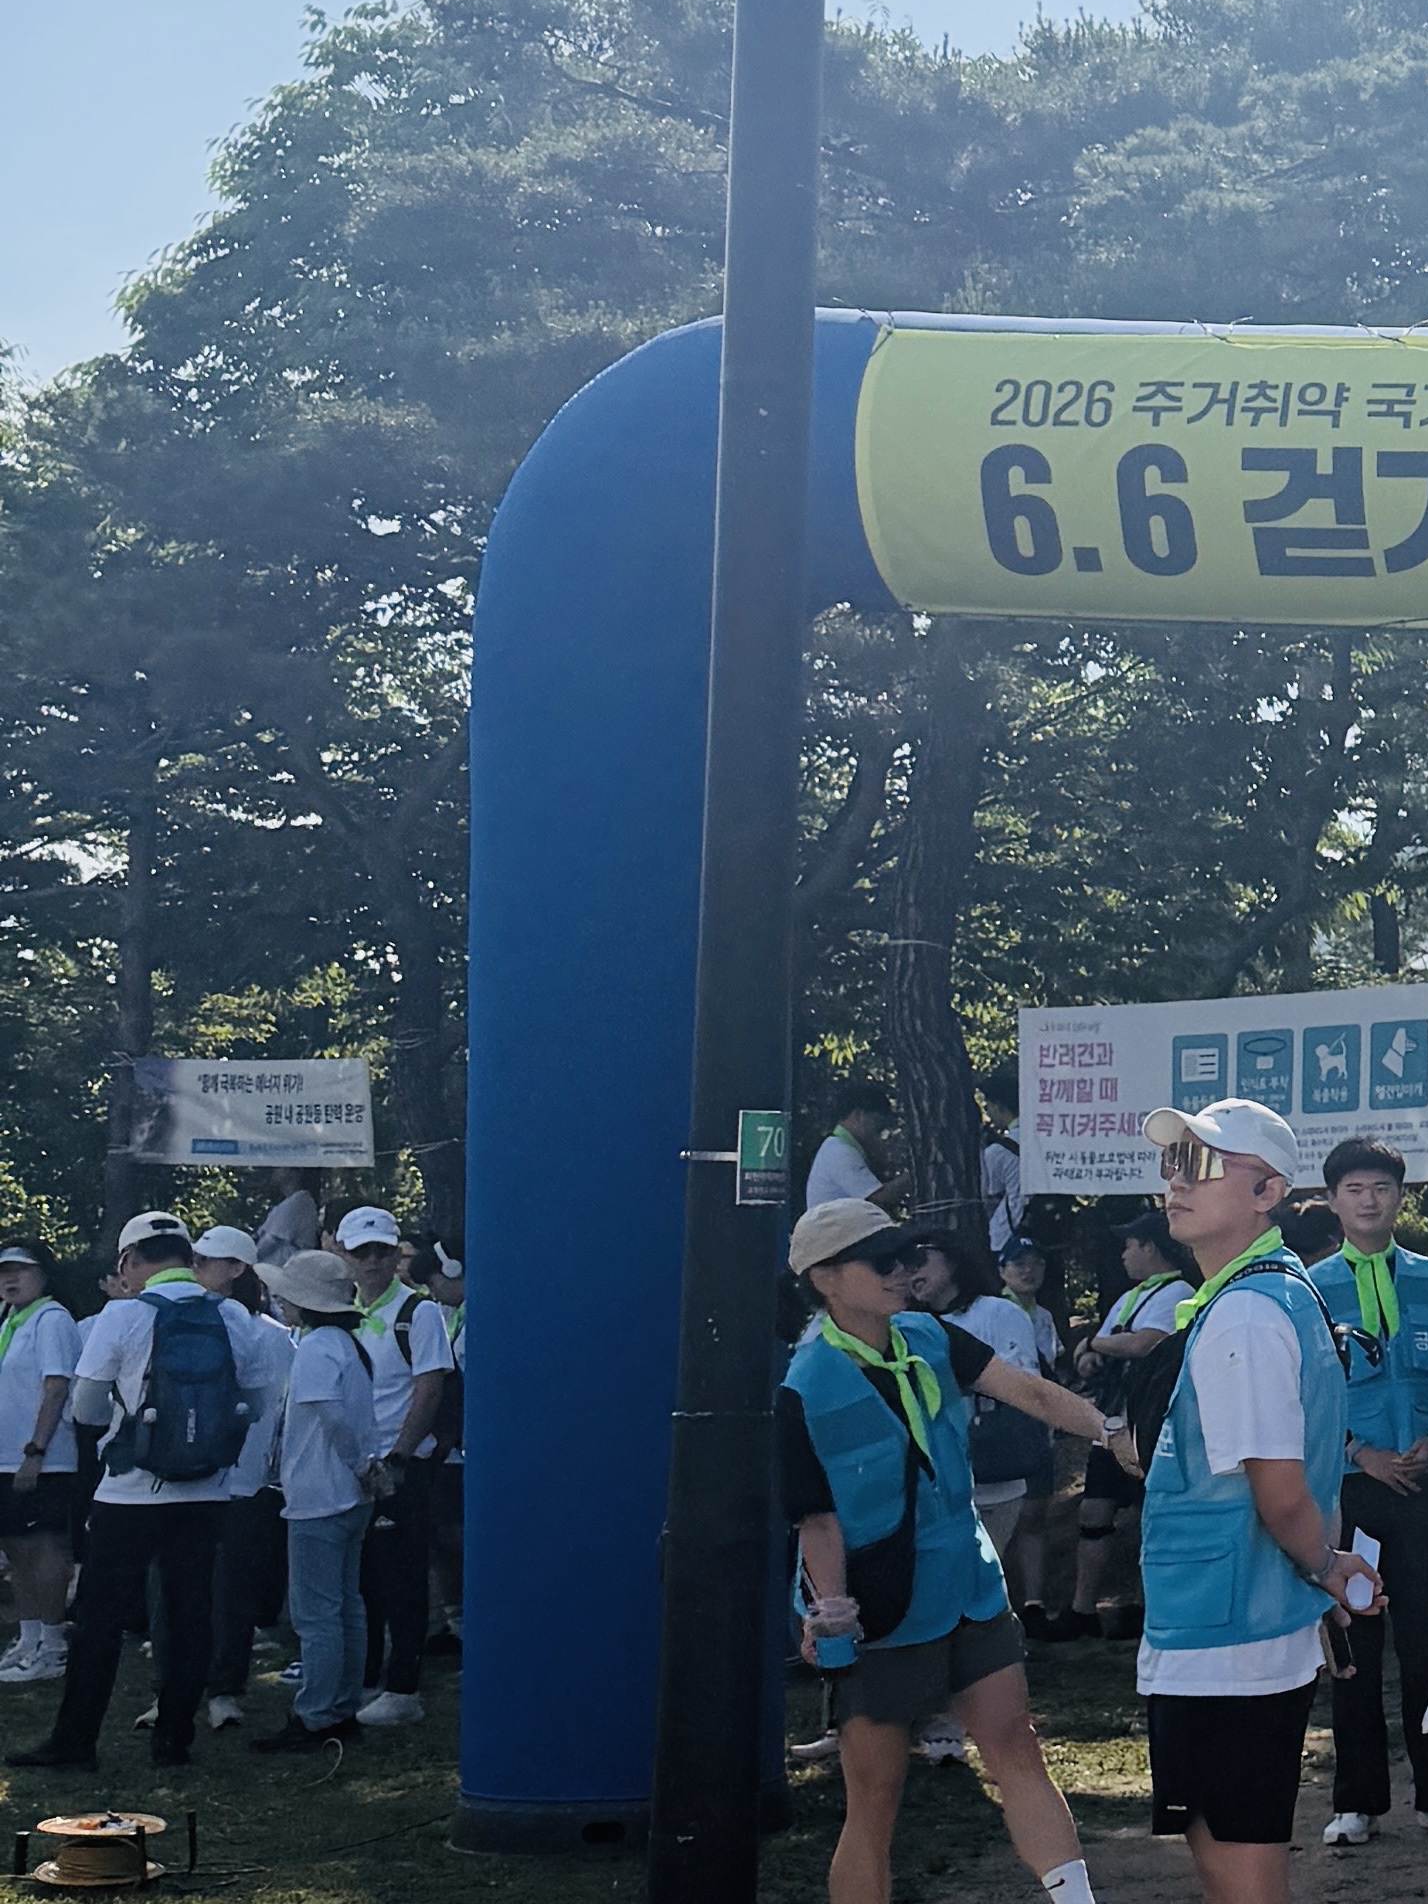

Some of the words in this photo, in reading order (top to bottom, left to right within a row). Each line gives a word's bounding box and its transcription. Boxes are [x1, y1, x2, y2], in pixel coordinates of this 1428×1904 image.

[991, 380, 1114, 428] 2026
[1132, 380, 1351, 430] 주거취약
[980, 443, 1199, 577] 6.6
[1038, 1042, 1114, 1068] 반려견과
[1038, 1077, 1094, 1104] 함께할
[1099, 1077, 1119, 1103] 때
[1036, 1113, 1054, 1138] 꼭
[757, 1126, 785, 1158] 70
